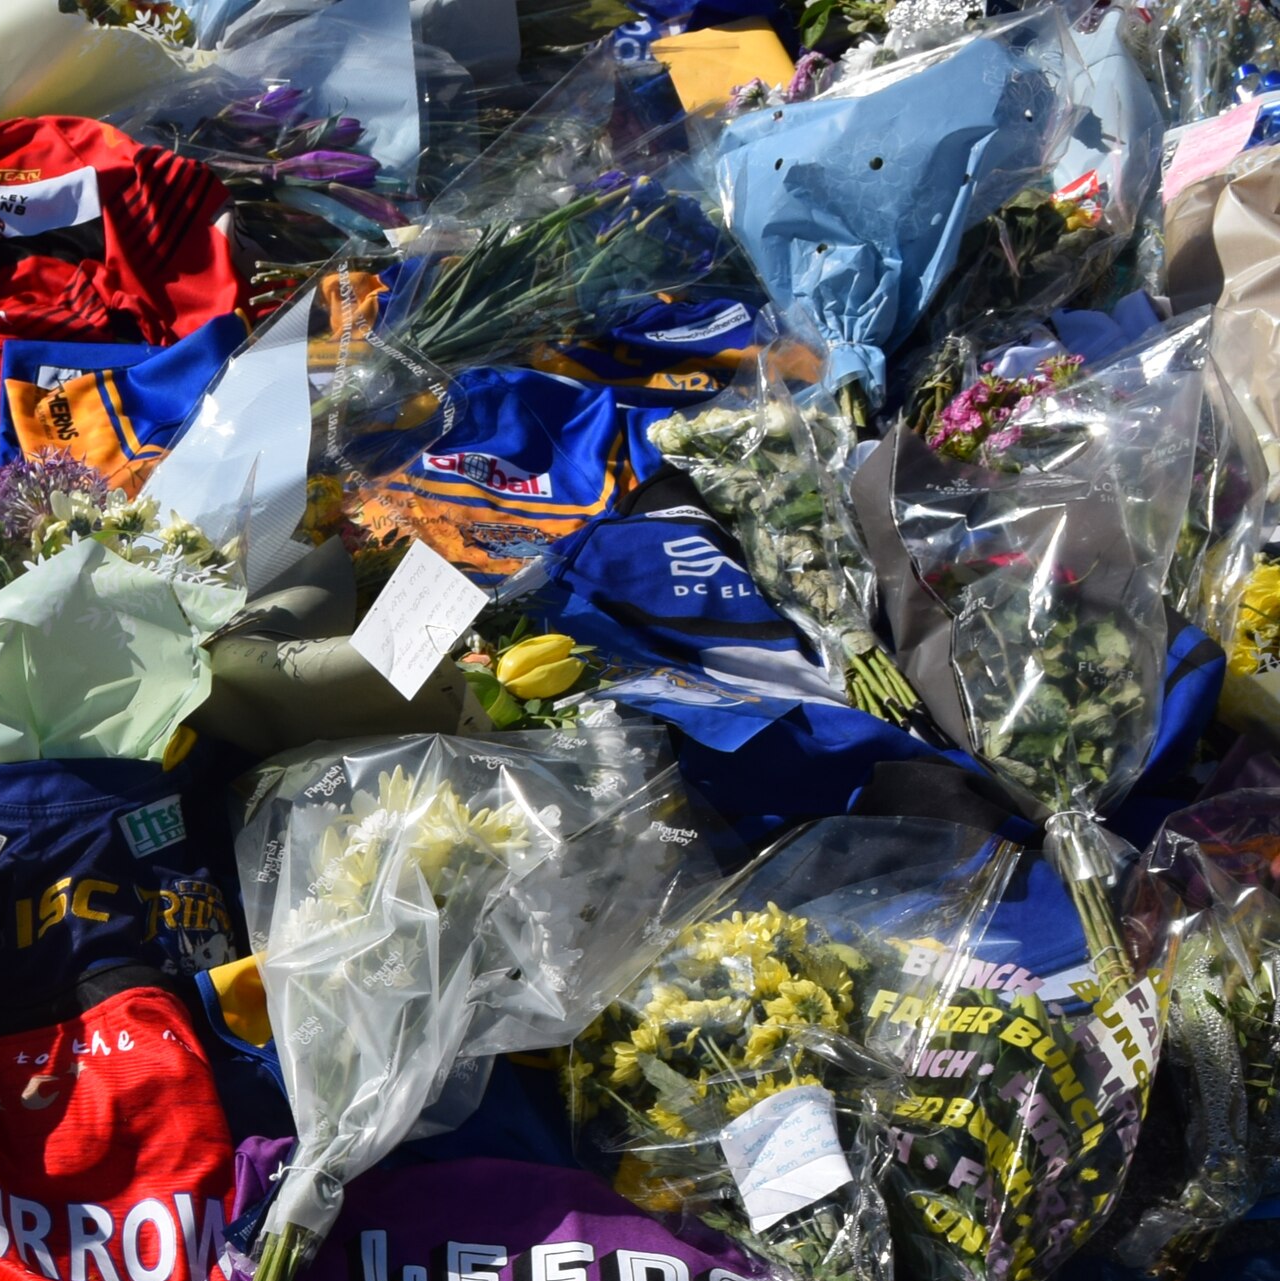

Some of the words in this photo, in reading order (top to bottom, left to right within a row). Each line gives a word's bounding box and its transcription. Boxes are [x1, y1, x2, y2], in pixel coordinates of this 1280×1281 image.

[649, 821, 699, 839] Flourish
[15, 876, 120, 950] ISC
[71, 1028, 136, 1056] the
